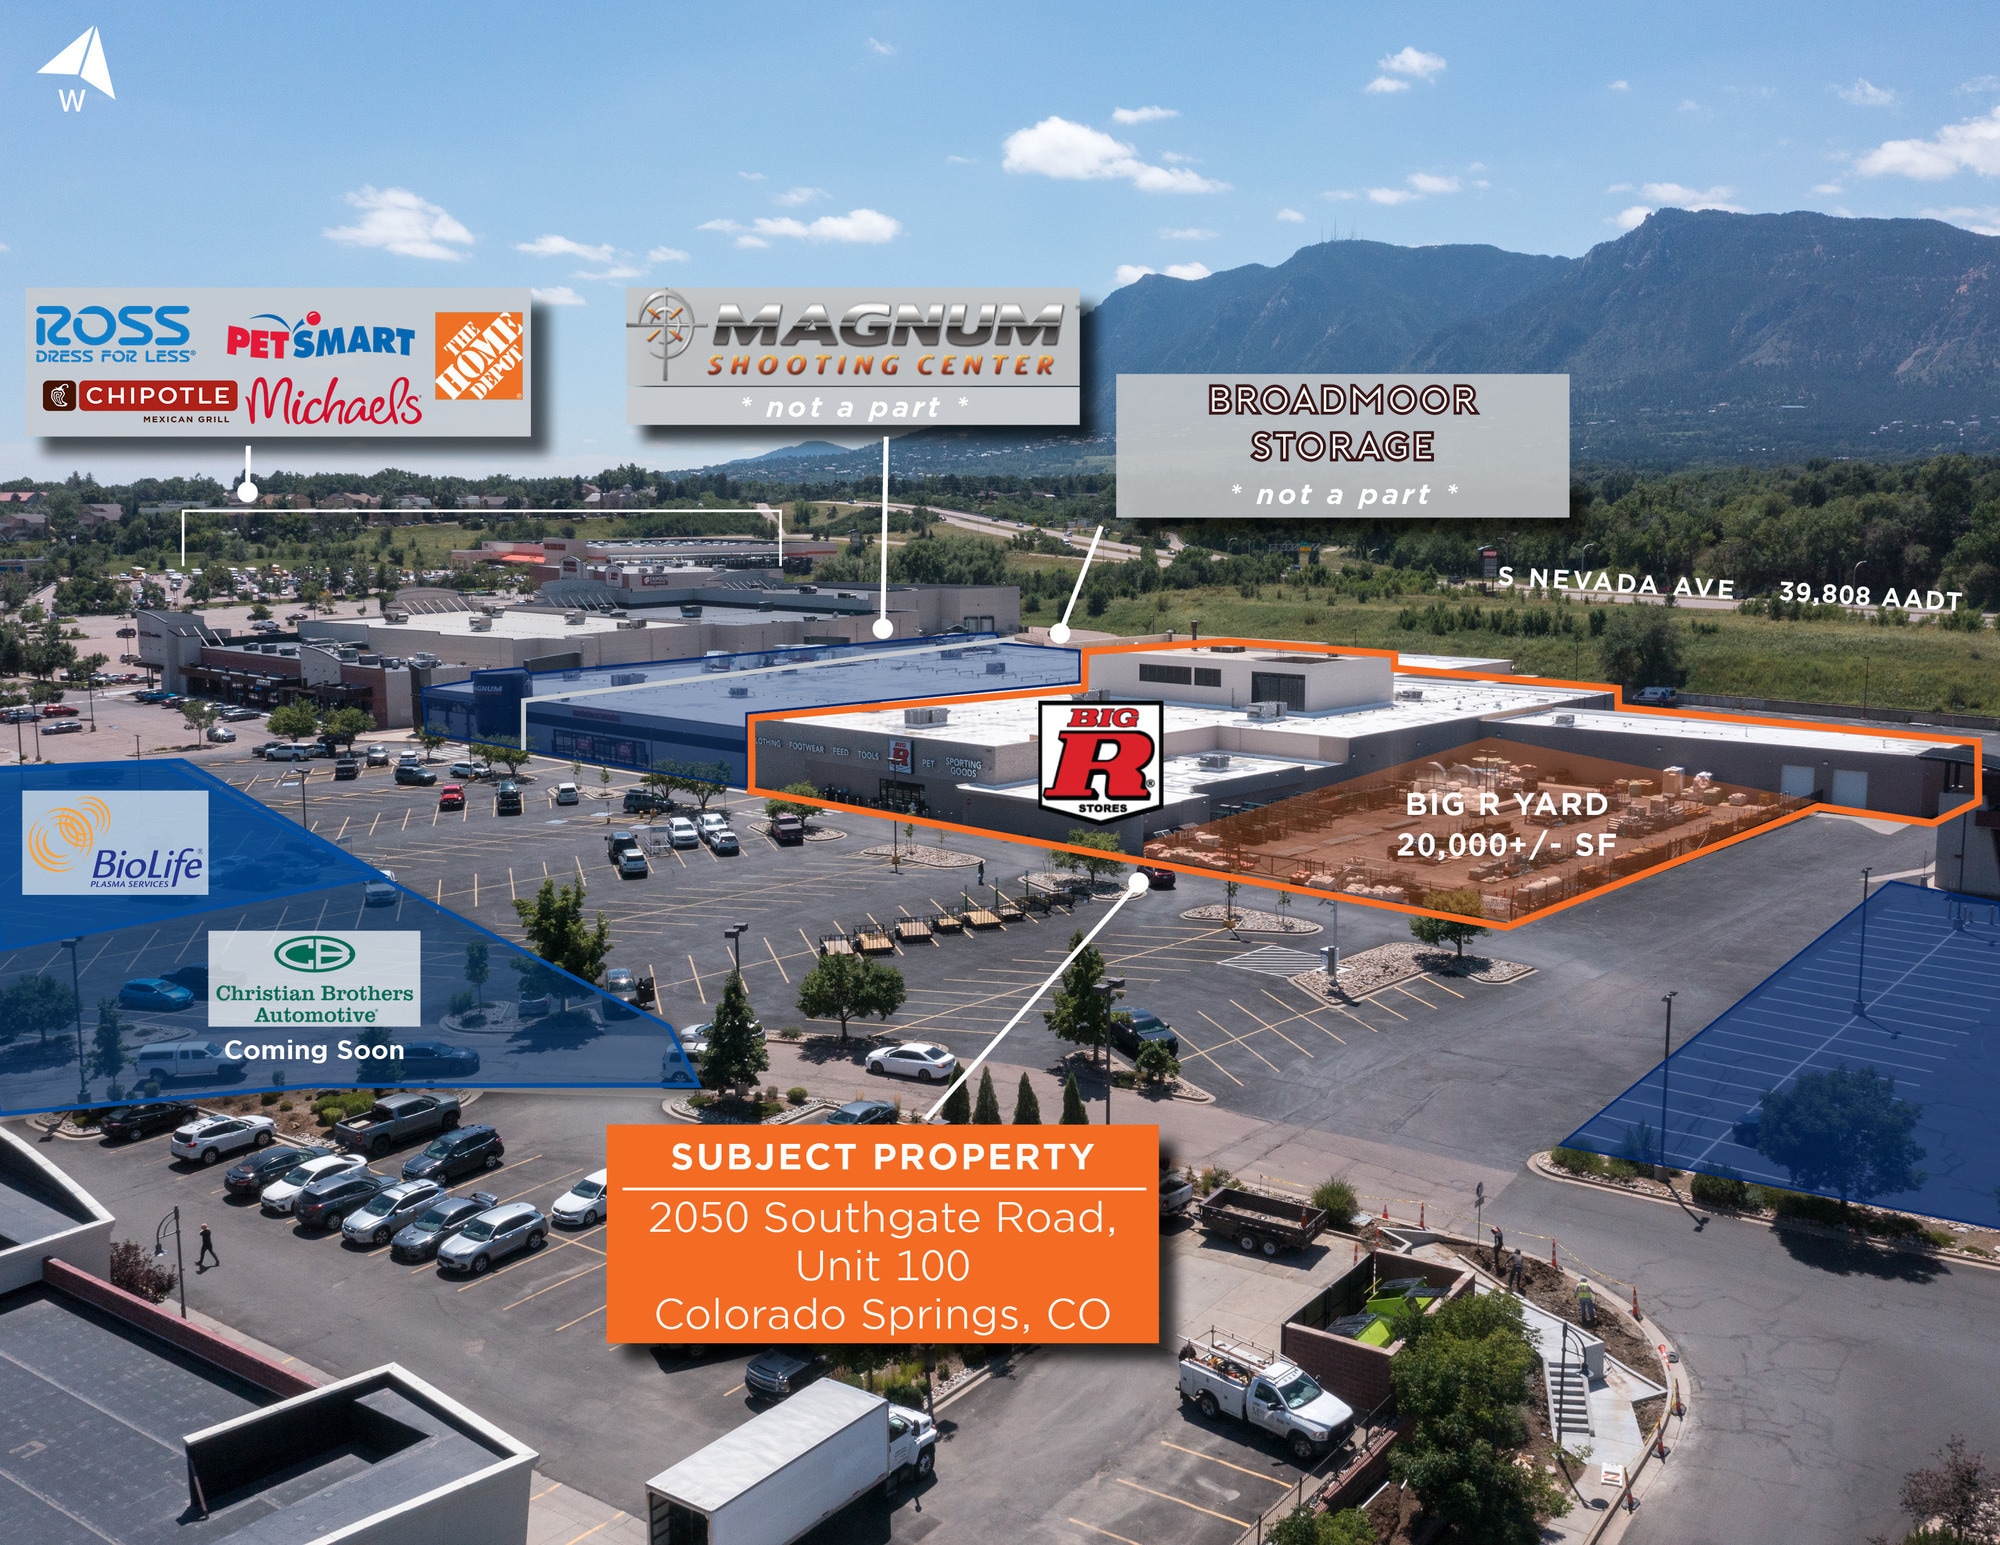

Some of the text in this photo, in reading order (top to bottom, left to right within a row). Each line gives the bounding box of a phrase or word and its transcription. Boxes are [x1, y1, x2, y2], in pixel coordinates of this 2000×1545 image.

[756, 737, 880, 761] LOTHING FOOTWEAR FEED TOOLS
[922, 759, 935, 768] PET
[945, 757, 982, 770] SPORTING
[950, 766, 977, 778] GOODS
